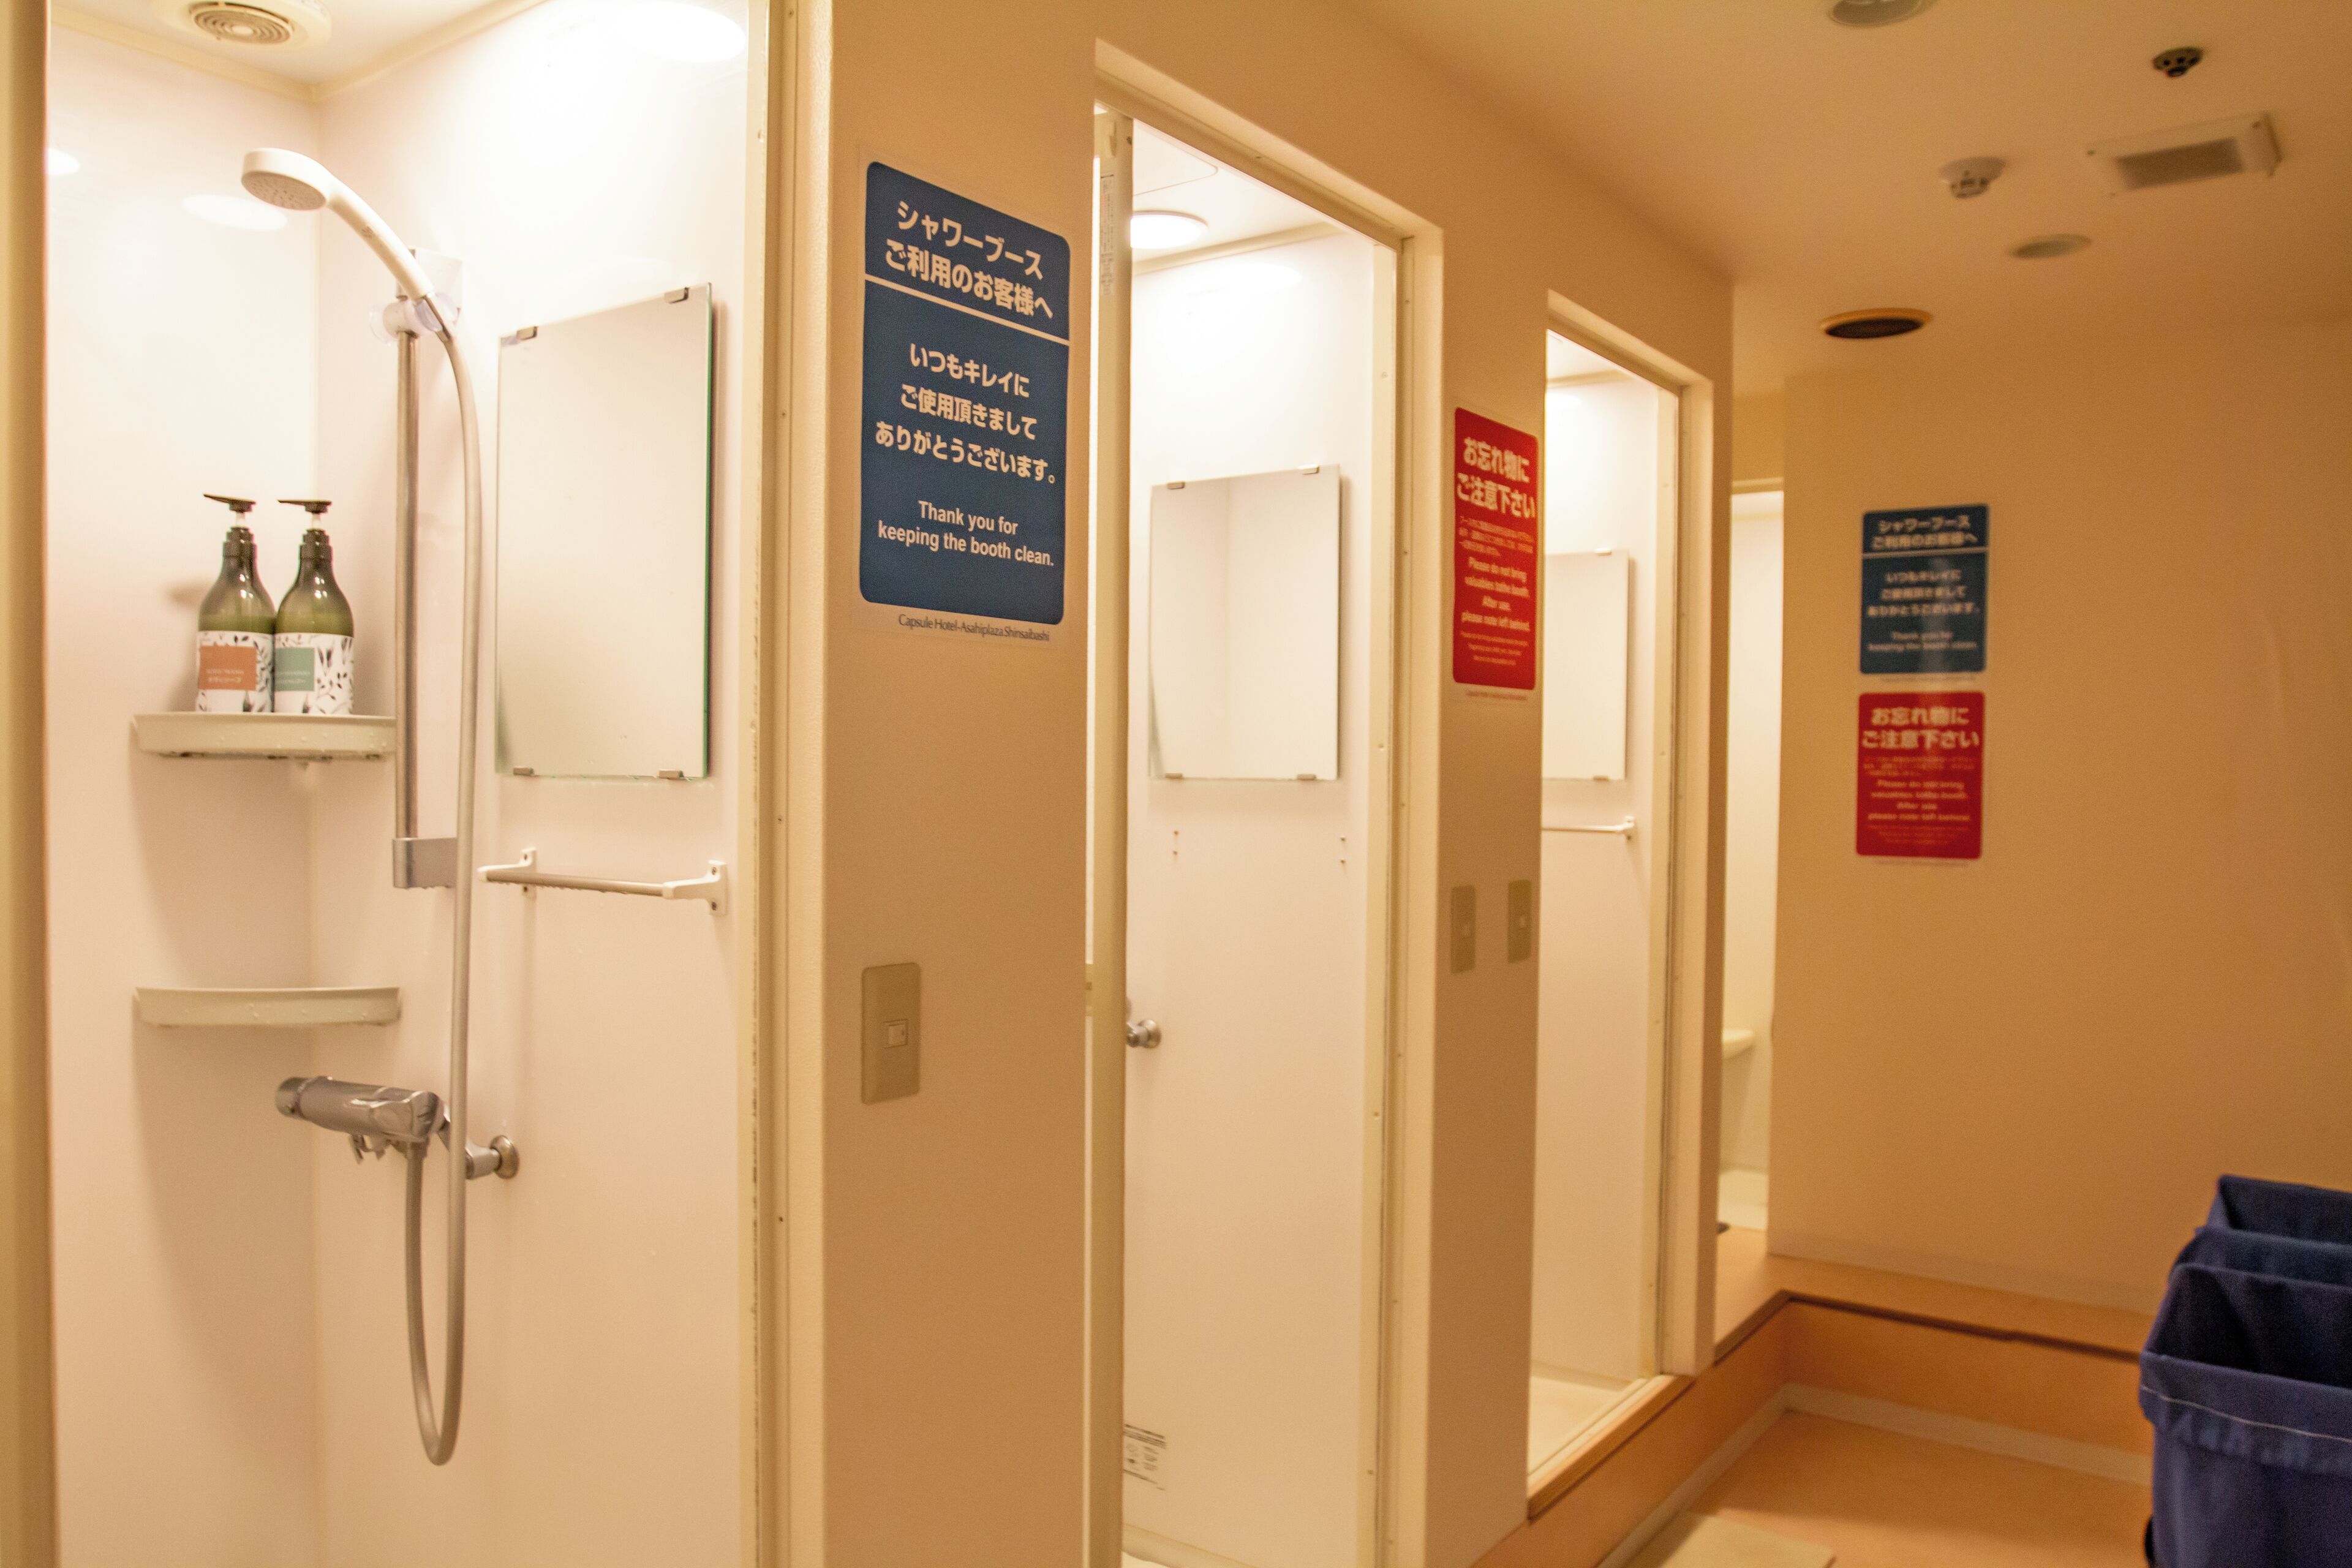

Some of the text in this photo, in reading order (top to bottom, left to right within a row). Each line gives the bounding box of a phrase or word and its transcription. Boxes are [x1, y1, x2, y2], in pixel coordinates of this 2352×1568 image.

[897, 200, 1043, 280] シャワーブース
[886, 238, 1053, 318] ご利用のお客様へ
[910, 342, 1030, 398] いつもキレイに
[900, 383, 1037, 440] ご使用頂きまして
[875, 420, 1055, 484] ありがとうございます。
[918, 500, 1019, 535] Thank you for
[1457, 472, 1536, 518] ご注意下さい
[878, 519, 1054, 566] keeping the booth clean.
[899, 614, 933, 630] Capsule
